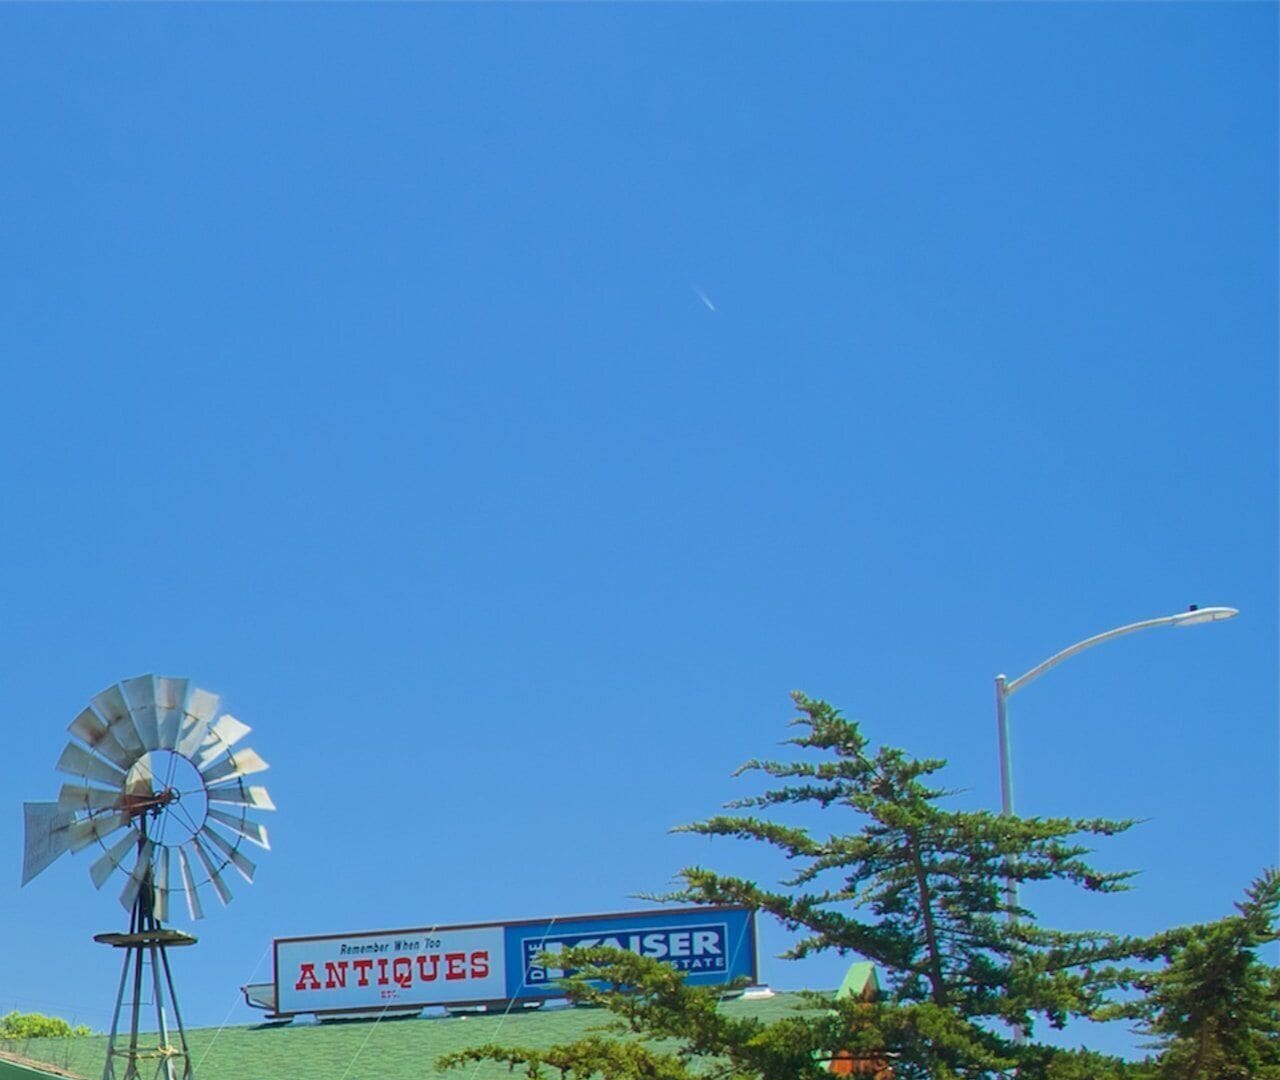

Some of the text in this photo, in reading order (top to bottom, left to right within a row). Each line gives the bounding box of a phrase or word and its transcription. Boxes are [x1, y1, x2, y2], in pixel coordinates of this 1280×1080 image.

[340, 936, 441, 956] Remember When Too
[295, 951, 489, 990] ANTIQUES
[660, 956, 725, 970] STATE
